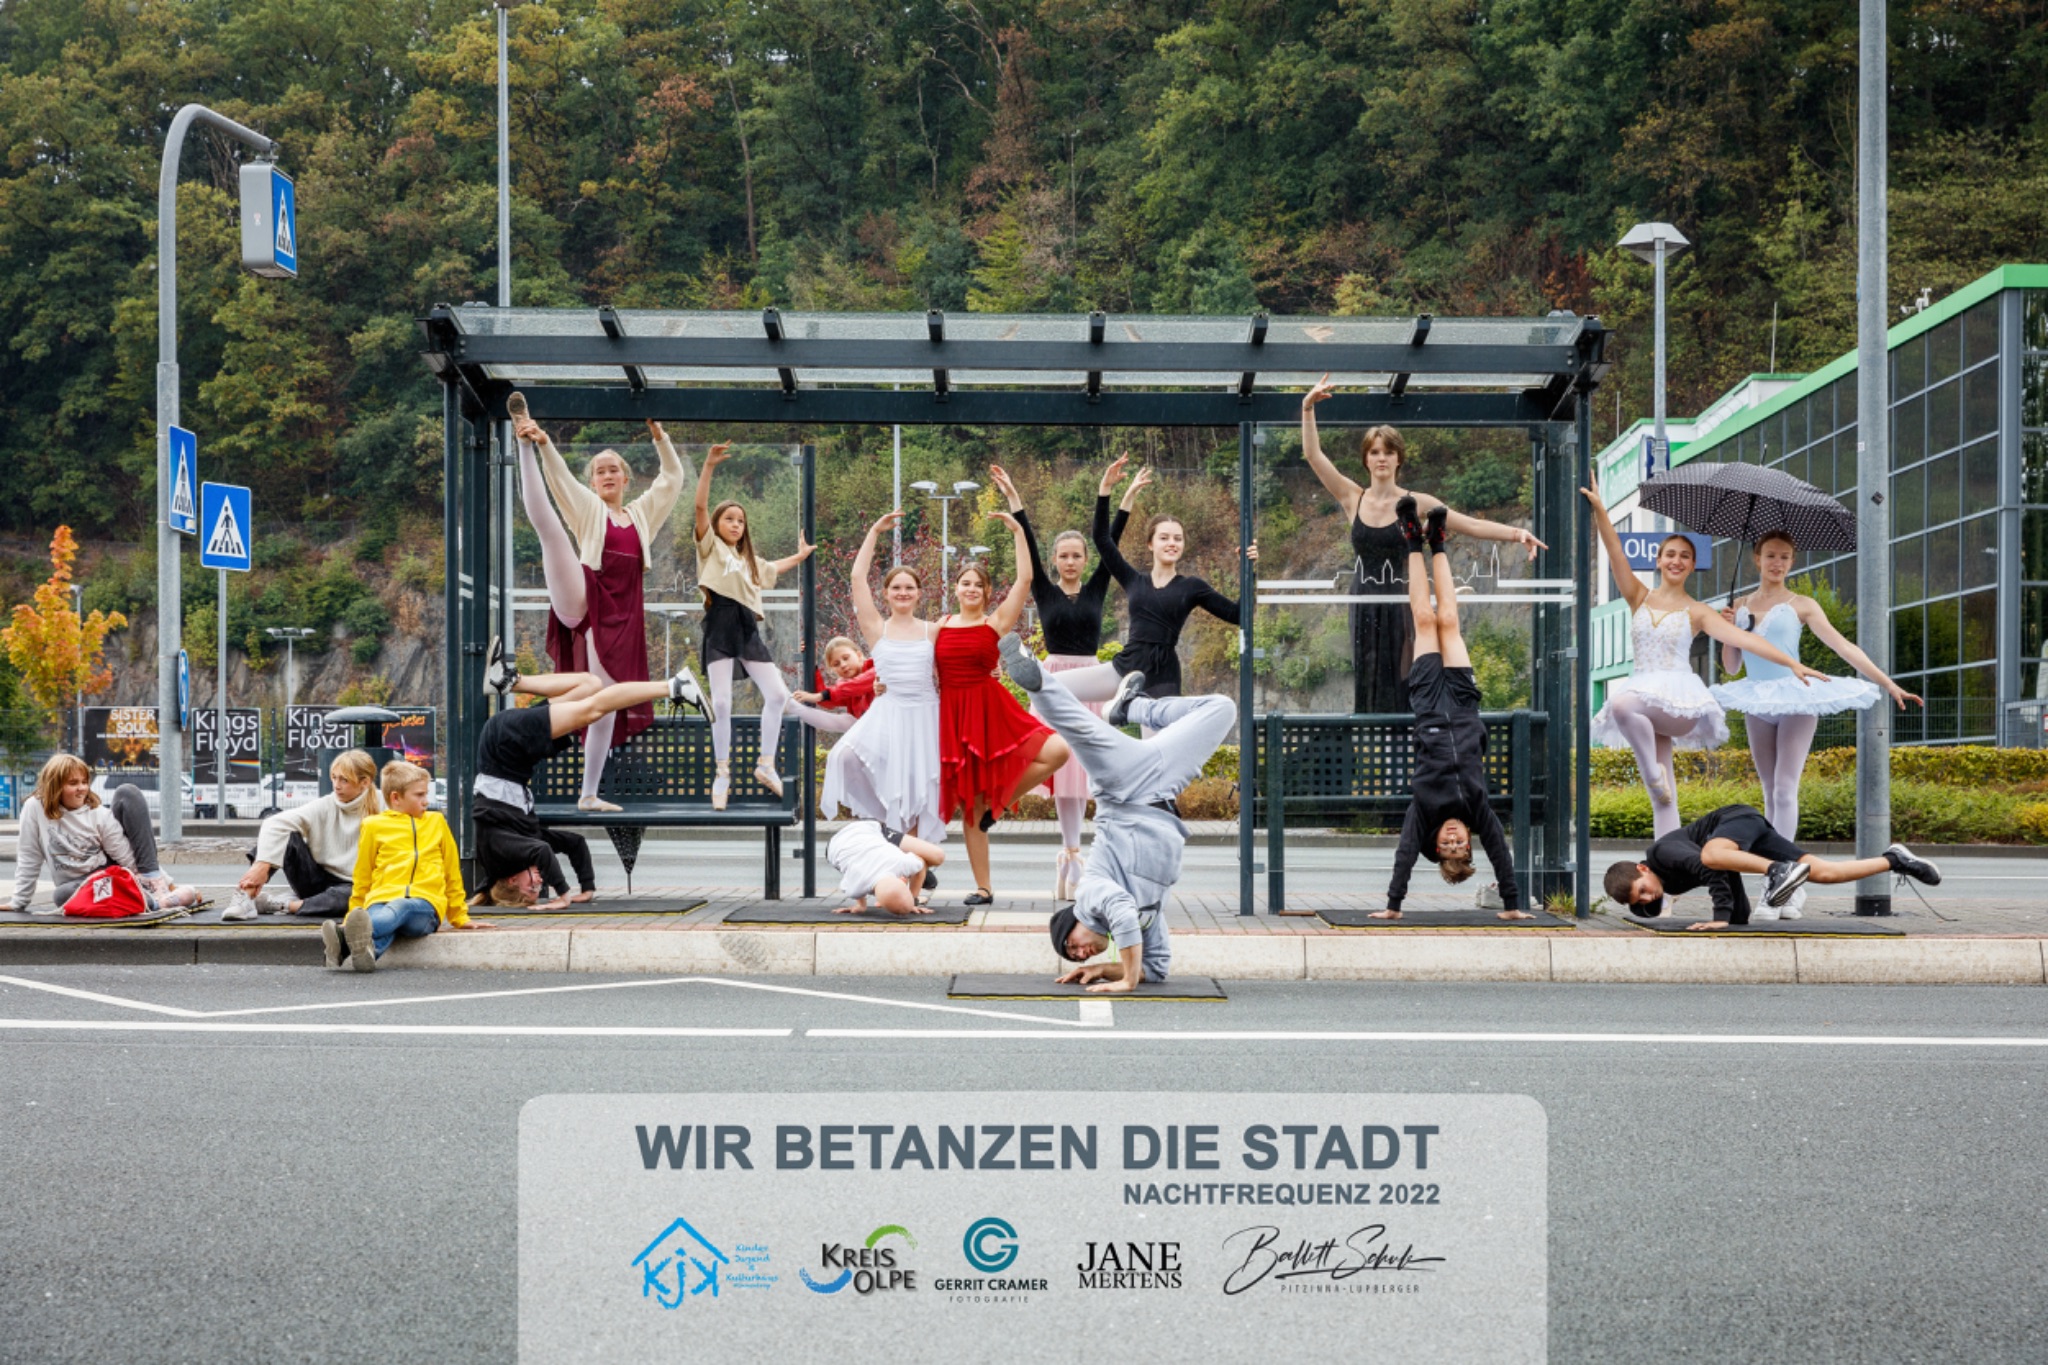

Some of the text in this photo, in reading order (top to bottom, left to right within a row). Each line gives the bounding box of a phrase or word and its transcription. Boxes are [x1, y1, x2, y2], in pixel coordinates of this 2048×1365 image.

[1624, 538, 1661, 562] Olp
[111, 709, 155, 720] SISTER
[116, 722, 149, 734] SOUL
[196, 731, 257, 756] Floyd
[288, 729, 348, 749] Floyd
